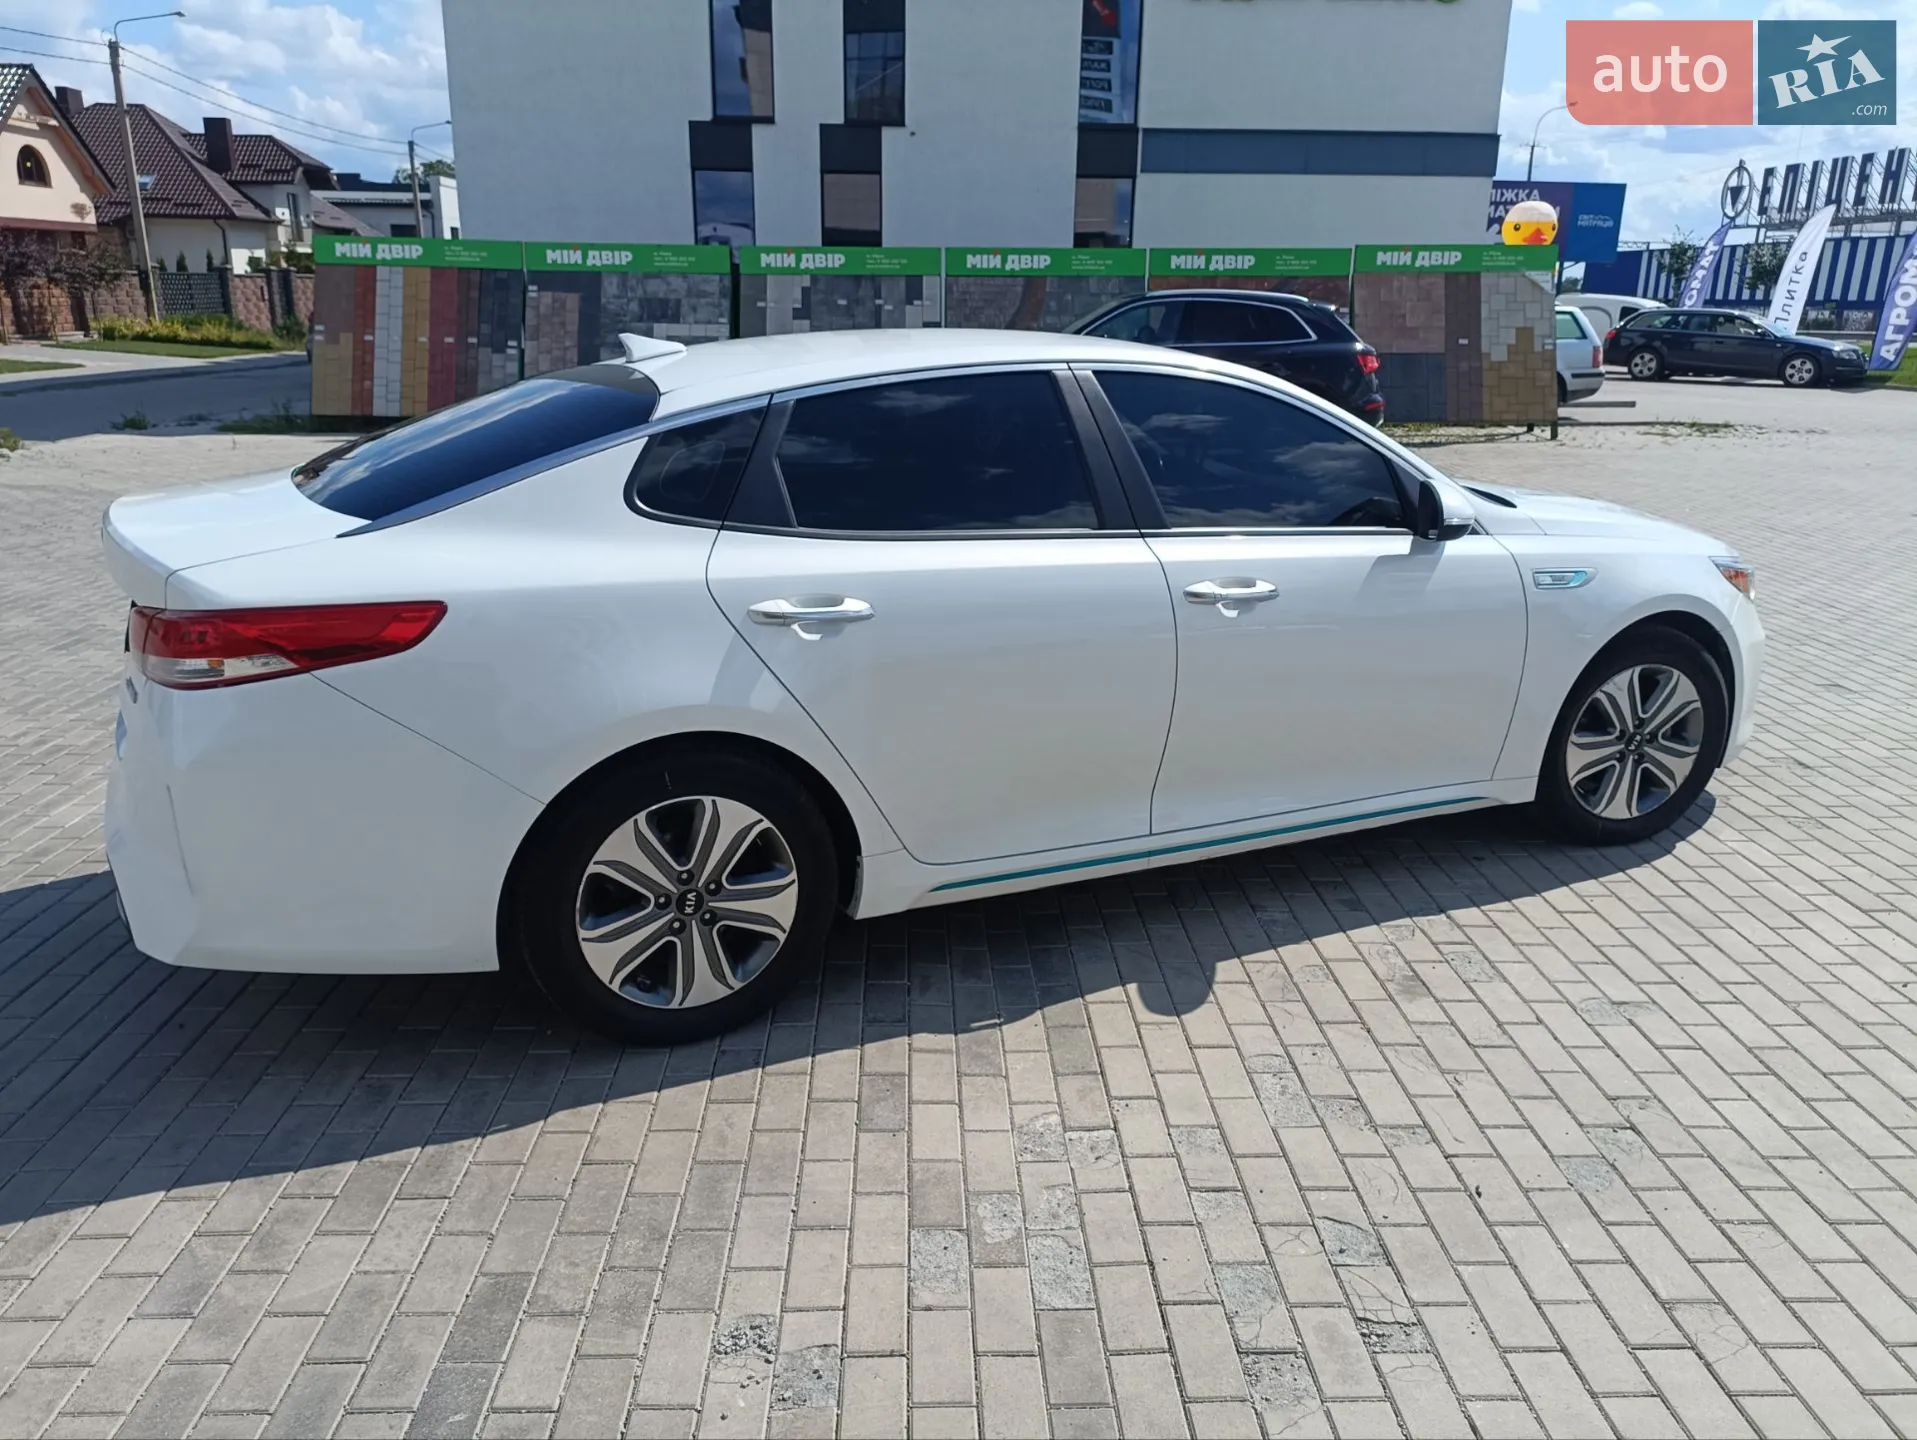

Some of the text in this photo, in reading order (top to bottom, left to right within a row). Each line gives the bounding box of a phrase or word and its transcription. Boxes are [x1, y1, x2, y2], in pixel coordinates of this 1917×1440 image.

[1757, 146, 1917, 217] ЕПІЦЕН
[334, 239, 371, 258] МІЙ
[376, 243, 424, 261] ДВІР
[546, 244, 583, 265] МІЙ
[586, 249, 633, 267] ДВІР
[760, 249, 796, 268] МІЙ
[799, 252, 846, 270] ДВІР
[966, 249, 1002, 269] МІЙ
[1005, 253, 1052, 271] ДВІР
[1170, 250, 1206, 270] МІЙ
[1209, 254, 1256, 272] ДВІР
[1376, 246, 1412, 266] МІЙ
[1415, 250, 1463, 268] ДВІР
[1684, 240, 1720, 308] ОМАТ
[1880, 248, 1917, 362] АГРОМ
[684, 892, 697, 914] KIA
